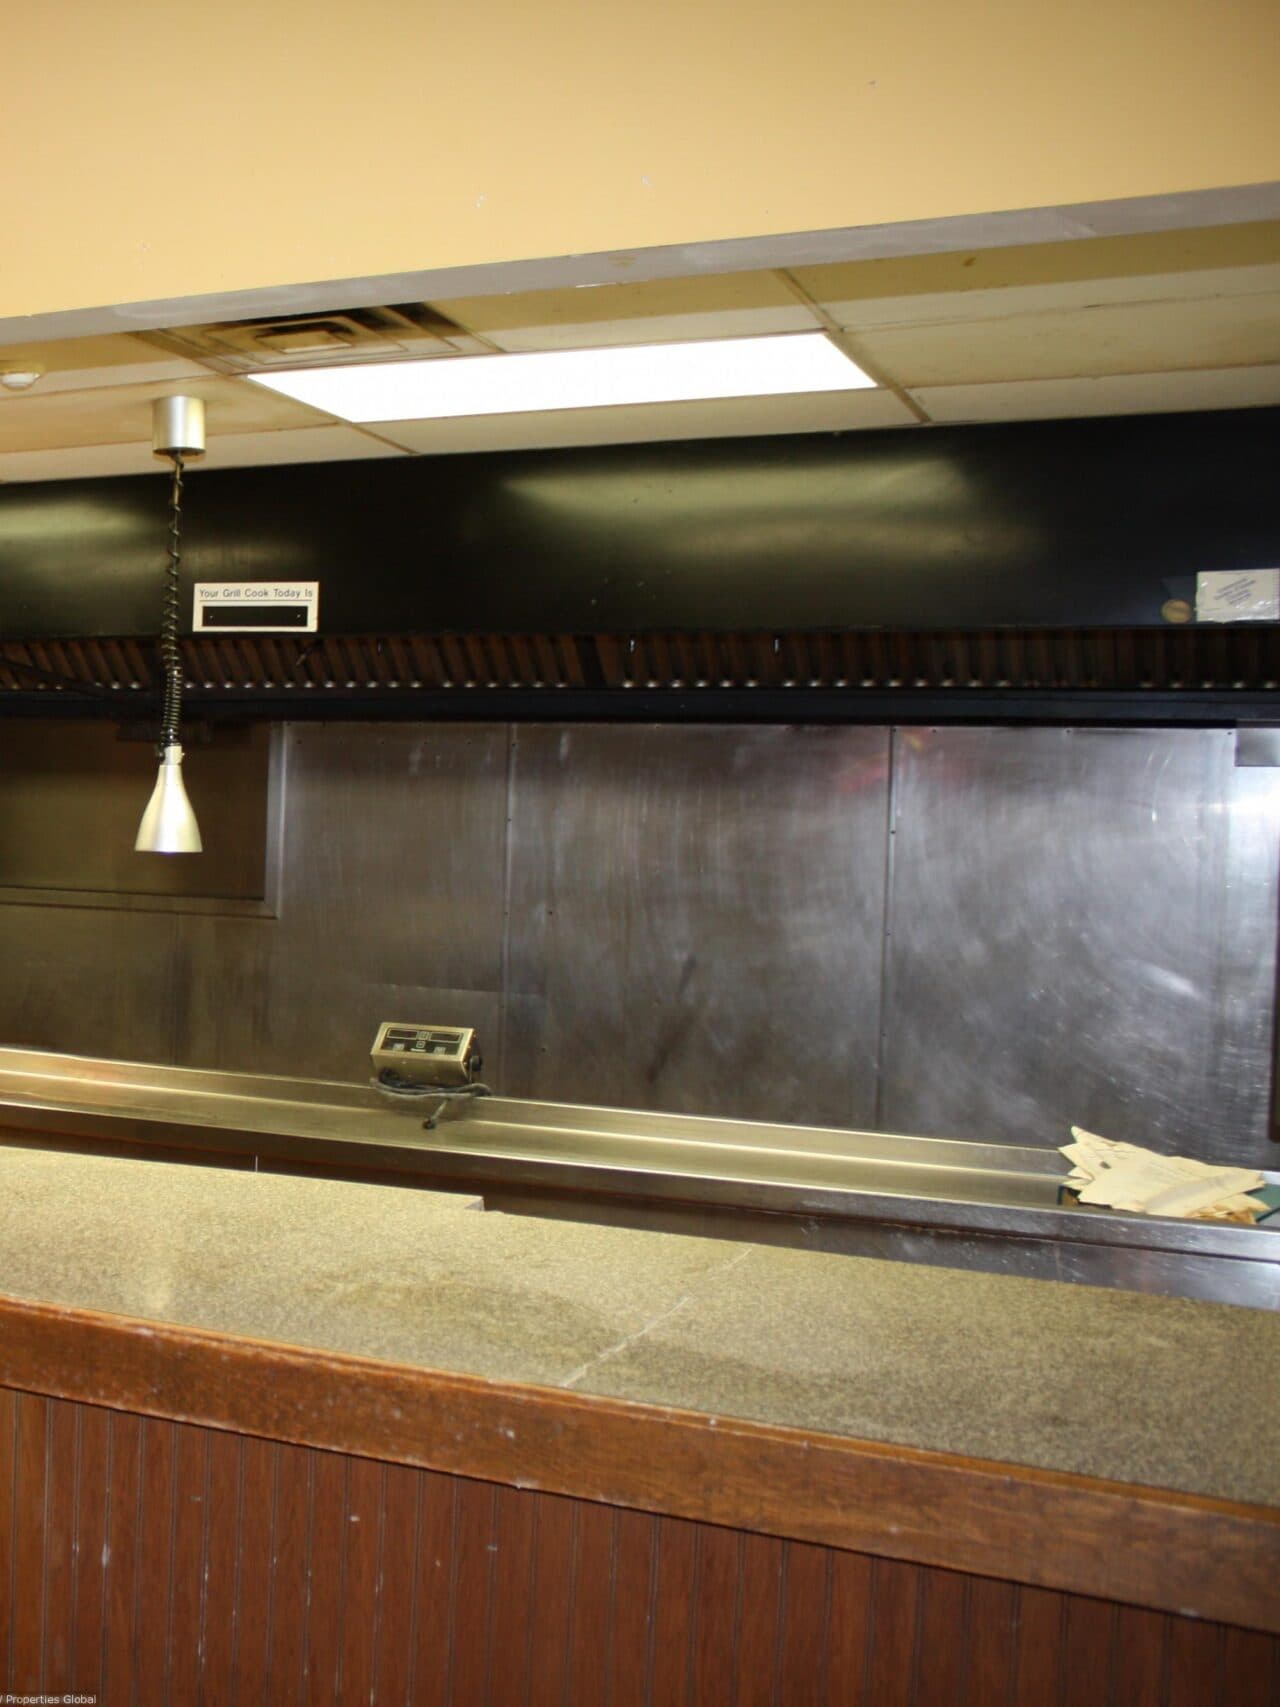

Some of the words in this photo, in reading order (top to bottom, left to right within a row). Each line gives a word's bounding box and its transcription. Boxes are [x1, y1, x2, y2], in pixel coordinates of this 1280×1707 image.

[199, 589, 219, 598] Your
[222, 588, 241, 598] Grill
[244, 588, 269, 598] Cook
[273, 588, 301, 599] Today
